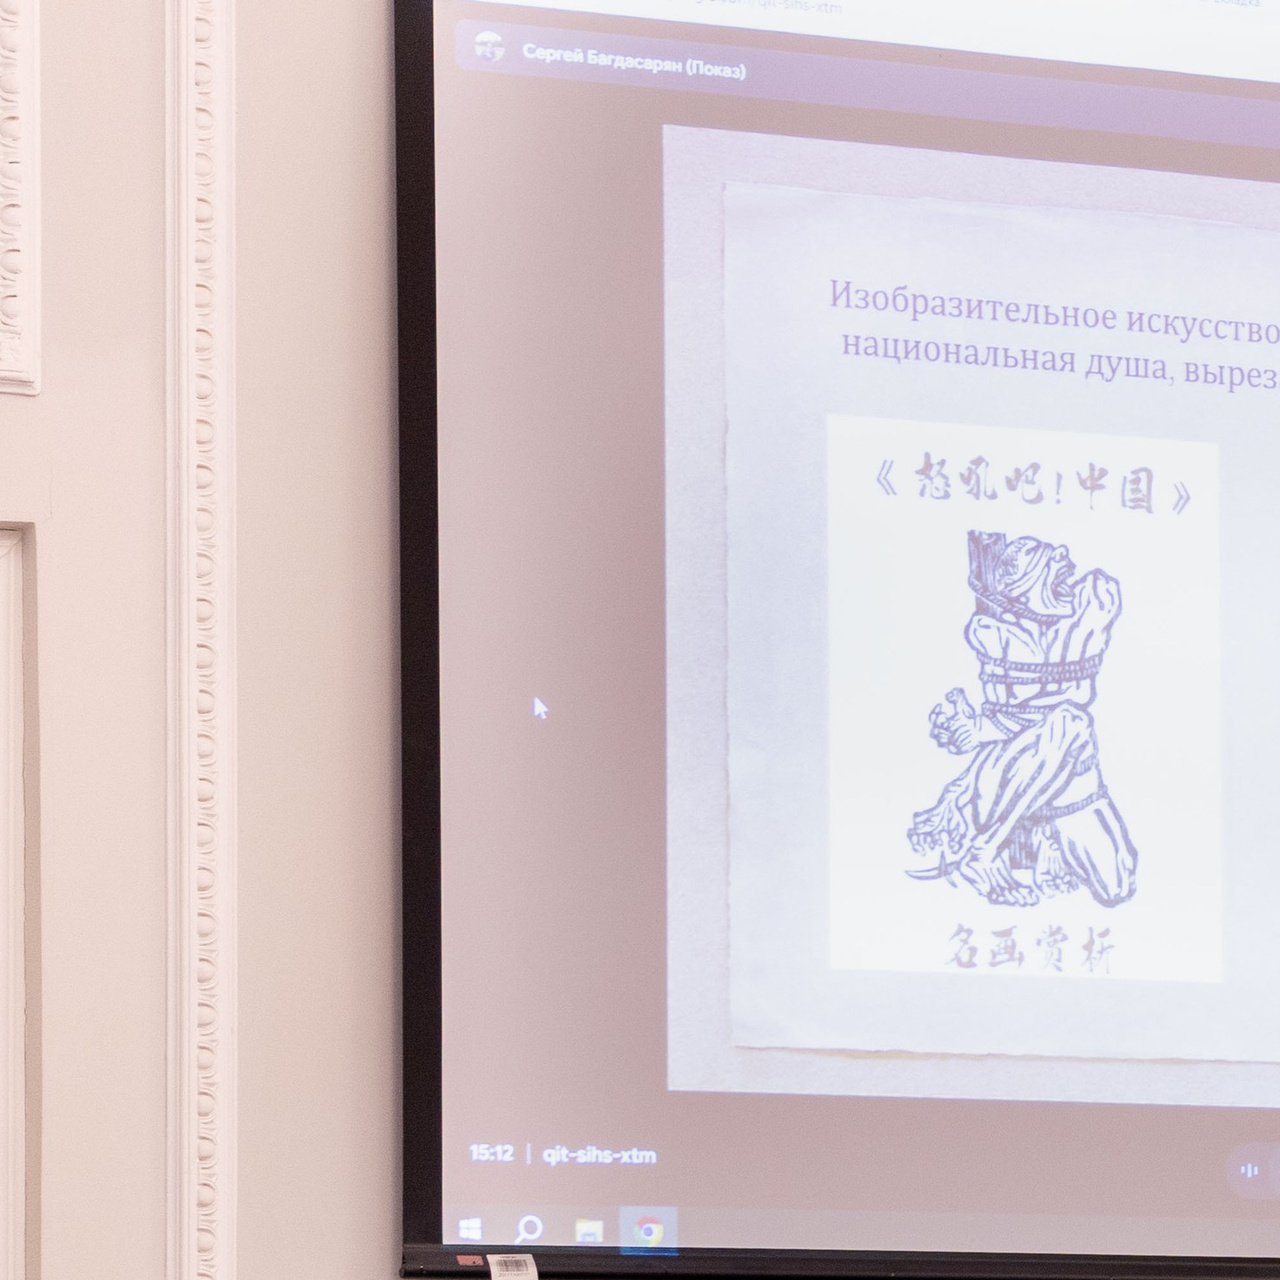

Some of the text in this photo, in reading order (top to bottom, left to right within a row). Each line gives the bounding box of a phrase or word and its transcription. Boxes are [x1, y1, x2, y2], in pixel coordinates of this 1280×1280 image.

[522, 43, 746, 81] Сергей Багдасарян (Показ)
[829, 279, 1118, 330] Изобразительное
[841, 333, 1076, 373] национальная
[1085, 352, 1176, 386] душа,
[946, 922, 1115, 974] 名画赏析
[469, 1143, 657, 1166] 15:12 qit-sihs-xtm
